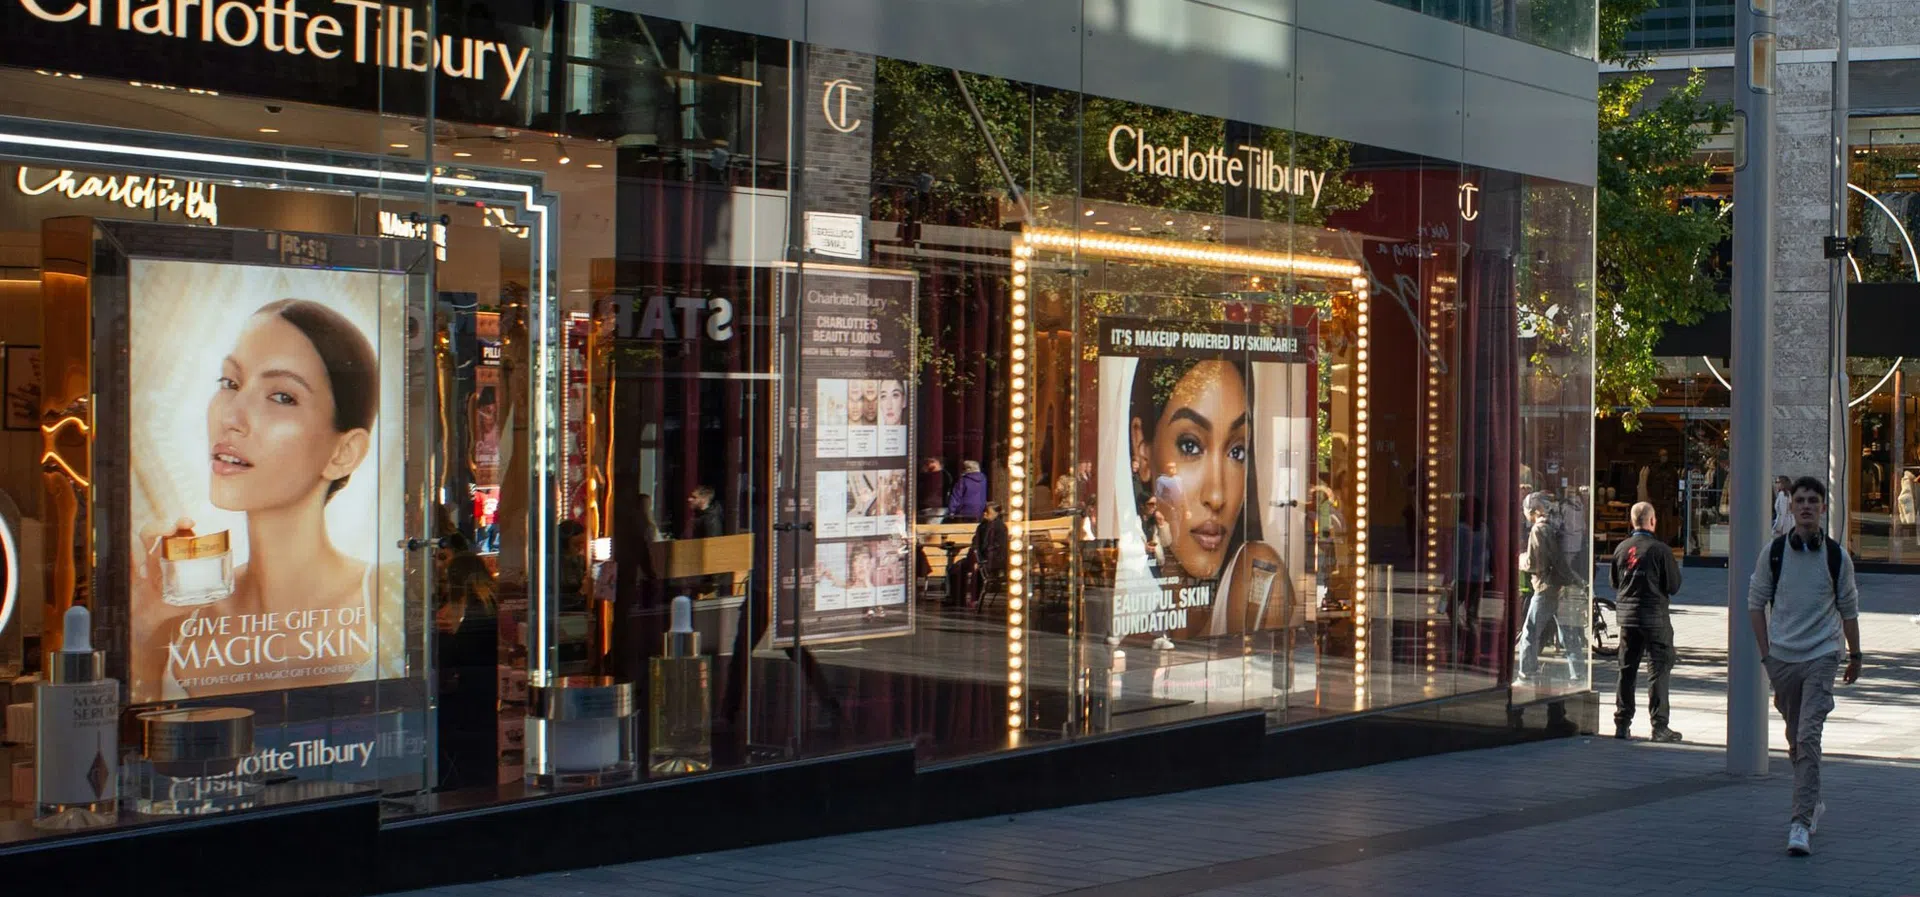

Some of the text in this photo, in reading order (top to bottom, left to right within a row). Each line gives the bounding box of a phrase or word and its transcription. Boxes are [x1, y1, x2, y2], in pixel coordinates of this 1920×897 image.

[1108, 124, 1326, 209] CharlotteTilbury
[807, 289, 888, 311] CharlotteTilbury
[812, 330, 881, 344] BEAUTY LOOKS
[1111, 328, 1298, 353] IT'S MAKEUP POWERED BY SKINCARE!
[1114, 586, 1210, 615] EAUTIFUL SKIN
[180, 606, 367, 638] GIVE THE GIFT OF
[1113, 609, 1188, 637] OUNDATION
[166, 625, 377, 672] MAGIC SKIN
[229, 672, 252, 683] GIFT
[290, 667, 312, 678] GIFT
